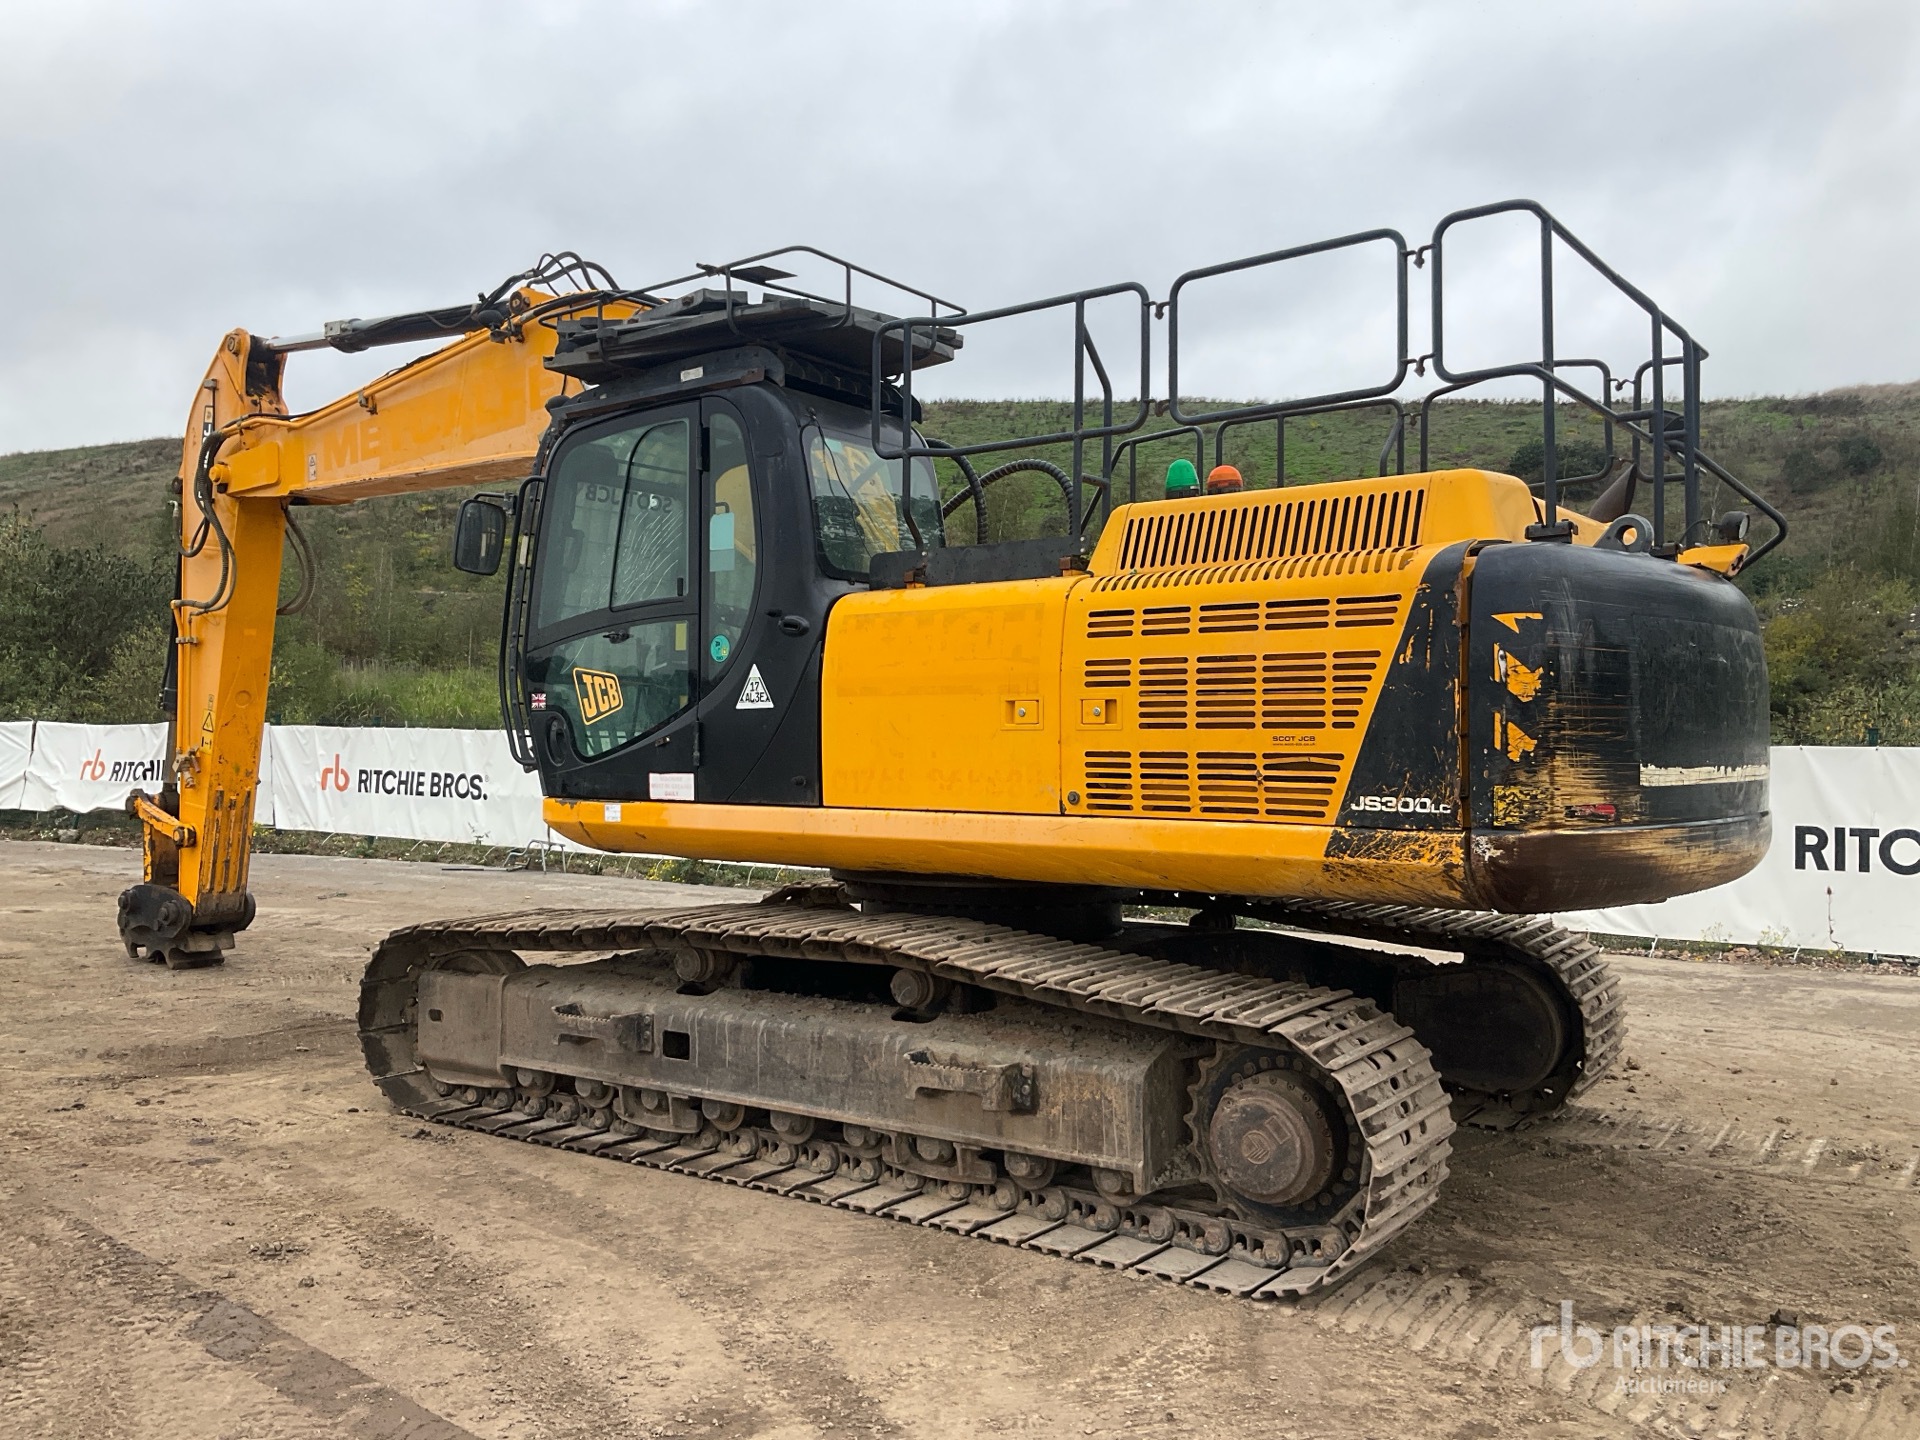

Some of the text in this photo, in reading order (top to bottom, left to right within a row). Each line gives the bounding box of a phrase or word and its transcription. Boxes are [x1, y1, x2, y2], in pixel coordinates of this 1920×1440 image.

[582, 673, 620, 718] JCB
[750, 681, 760, 692] 17
[320, 753, 488, 801] rb RITCHIE BROS.
[1350, 795, 1452, 814] JS300LC
